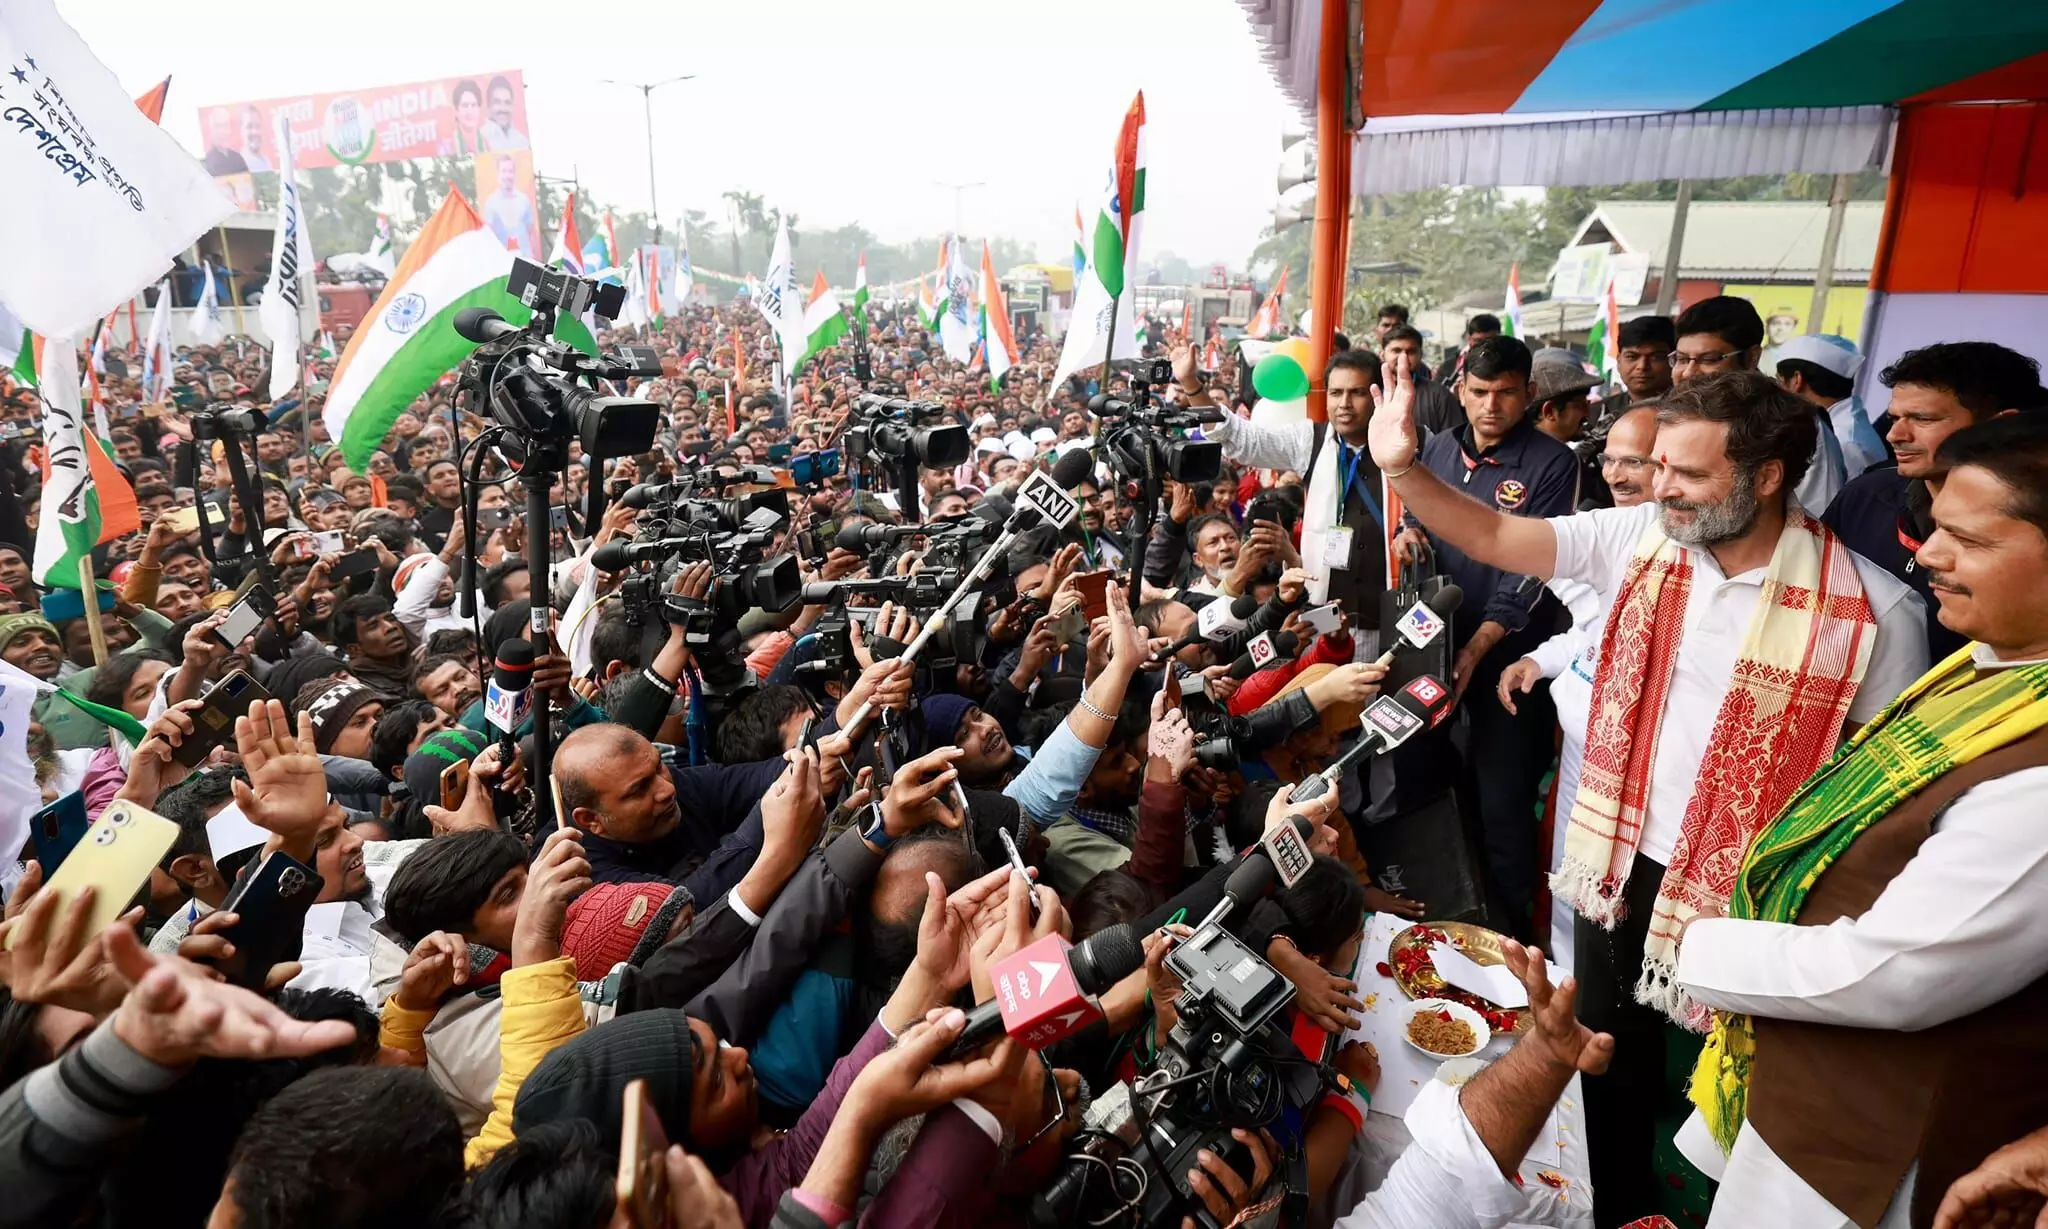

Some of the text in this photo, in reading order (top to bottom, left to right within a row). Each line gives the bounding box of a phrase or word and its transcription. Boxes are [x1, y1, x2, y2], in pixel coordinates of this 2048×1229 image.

[373, 84, 449, 122] INDIA
[3, 106, 97, 187] দেশপ্রেম
[379, 119, 438, 152] जीतेगा
[98, 155, 145, 212] প্রগতি
[1027, 484, 1071, 520] ANI
[1412, 680, 1438, 700] 18
[1379, 704, 1403, 723] NEWS
[1275, 839, 1299, 876] TIME
[1282, 831, 1307, 868] NEWS
[1016, 970, 1031, 1001] abp
